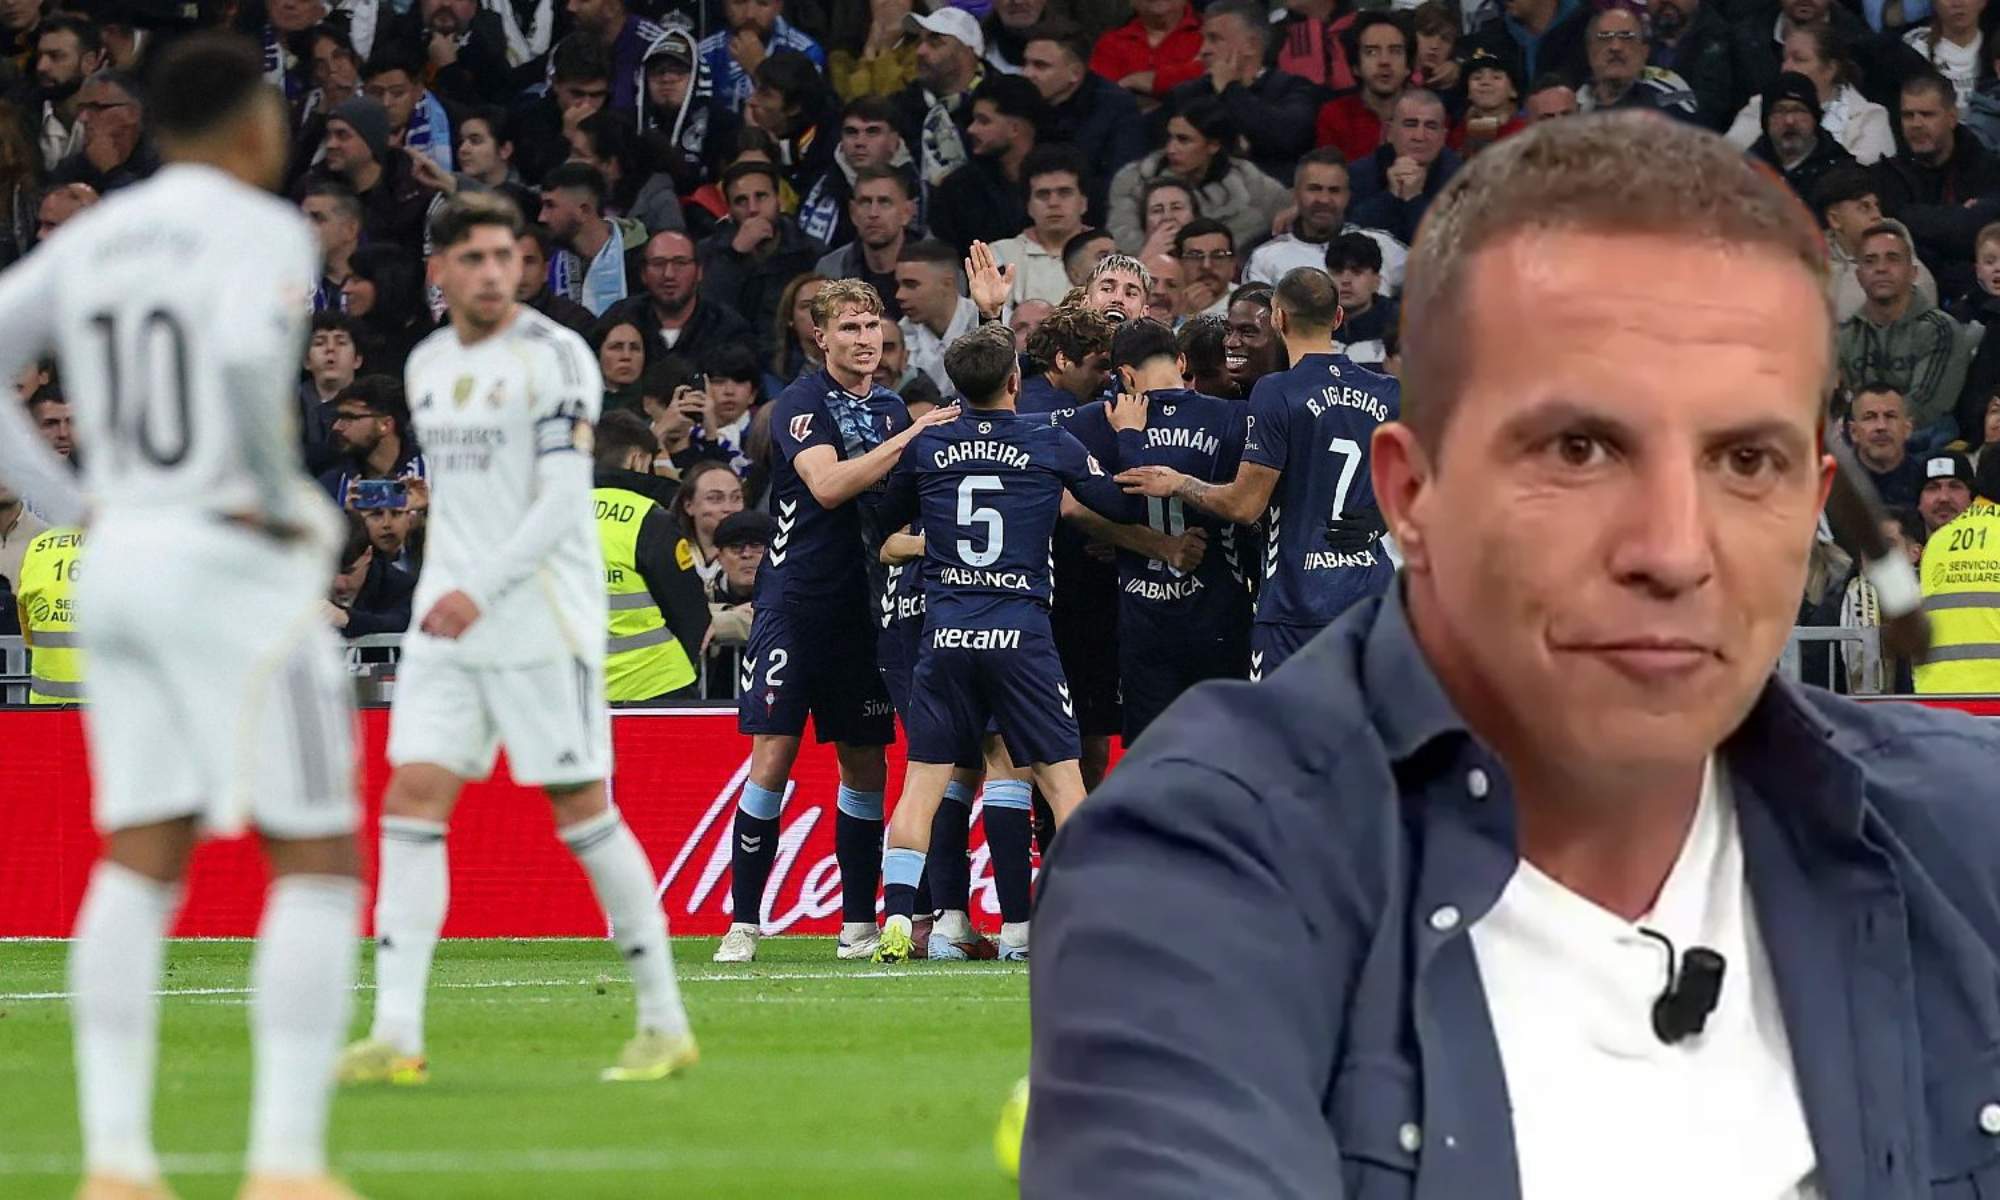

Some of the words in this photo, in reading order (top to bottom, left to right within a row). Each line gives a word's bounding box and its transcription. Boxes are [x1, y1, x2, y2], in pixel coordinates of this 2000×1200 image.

[91, 308, 191, 468] 10
[1306, 398, 1326, 418] B.
[1322, 385, 1389, 423] IGLESIAS
[933, 440, 1030, 470] CARREIRA
[1327, 437, 1362, 521] 7
[956, 475, 1004, 568] 5
[1948, 527, 1988, 552] 201
[765, 648, 788, 687] 2
